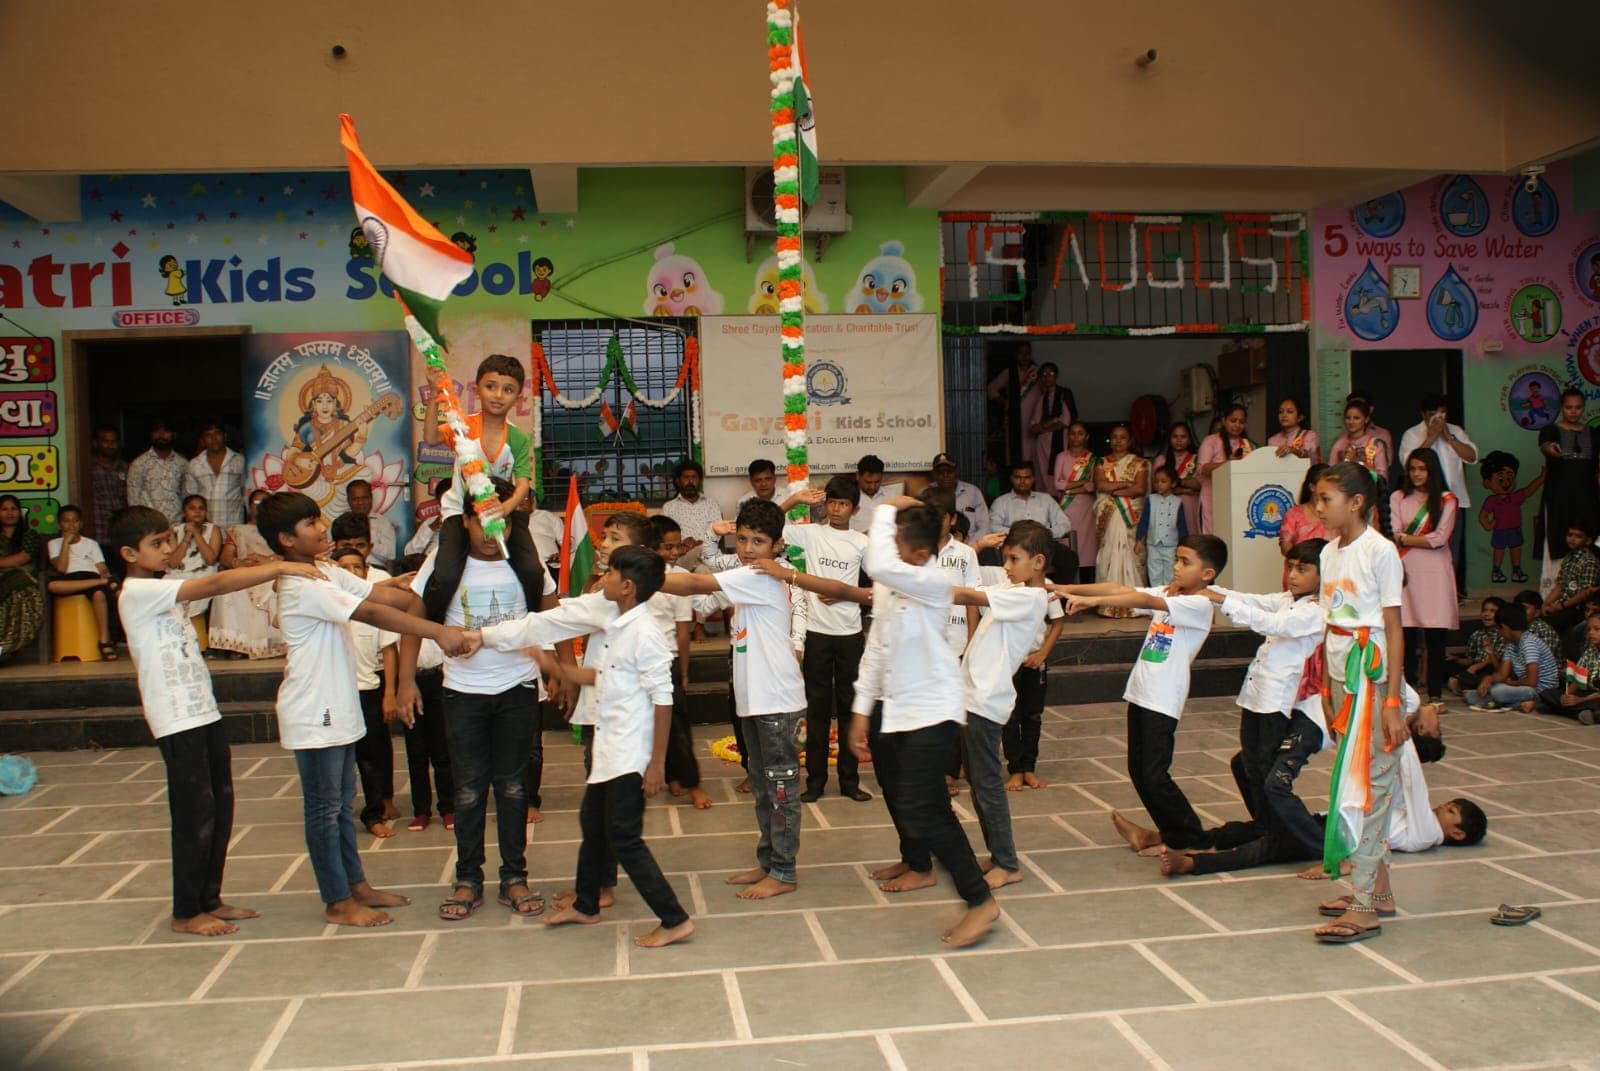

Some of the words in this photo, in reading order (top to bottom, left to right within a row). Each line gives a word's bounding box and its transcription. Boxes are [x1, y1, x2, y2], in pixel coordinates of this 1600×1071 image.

[1324, 224, 1349, 258] 5
[1356, 241, 1402, 263] ways
[1407, 237, 1425, 257] to
[1434, 233, 1478, 259] Save
[1485, 235, 1545, 259] Water
[967, 223, 1027, 300] 15
[1053, 222, 1303, 294] AUGUST
[186, 254, 316, 304] Kids
[122, 311, 186, 327] OFFICE
[721, 323, 750, 335] Shree
[836, 322, 845, 333] &
[846, 322, 893, 333] Charitable
[895, 322, 919, 333] Trust
[1567, 319, 1592, 347] WHEN
[1566, 353, 1585, 389] KNOW
[836, 415, 871, 430] Kids
[876, 413, 932, 430] School
[815, 435, 854, 445] ENGLISH
[709, 464, 729, 473] Email
[818, 557, 849, 570] GUCCI
